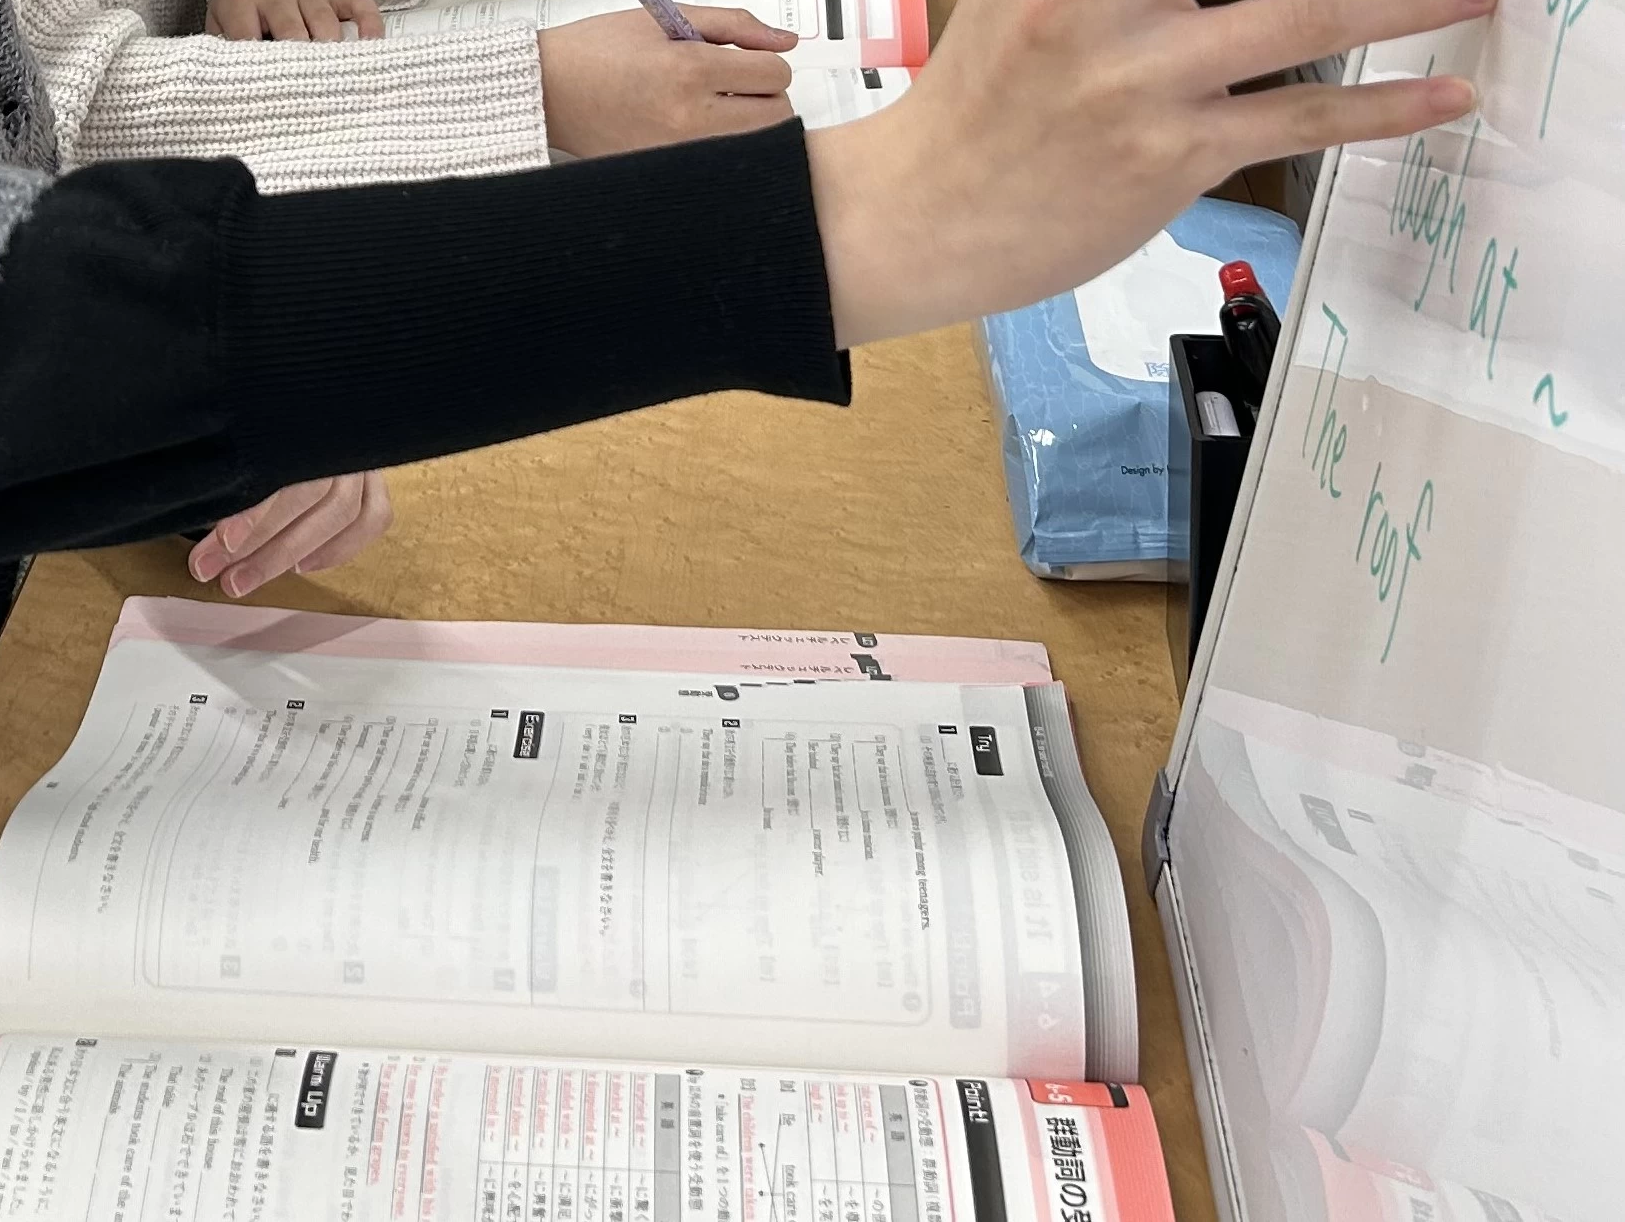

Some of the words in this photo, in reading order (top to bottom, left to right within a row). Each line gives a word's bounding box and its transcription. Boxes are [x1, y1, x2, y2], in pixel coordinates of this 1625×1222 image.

[1469, 235, 1520, 380] at
[1120, 465, 1150, 477] Design
[1152, 464, 1164, 476] by
[1302, 302, 1346, 499] The
[1353, 461, 1433, 664] roof
[975, 734, 993, 752] Try
[918, 879, 931, 930] teenagers.
[310, 1054, 331, 1086] Warm
[301, 1091, 324, 1116] Up
[963, 1081, 990, 1123] Point!
[204, 1138, 219, 1170] house
